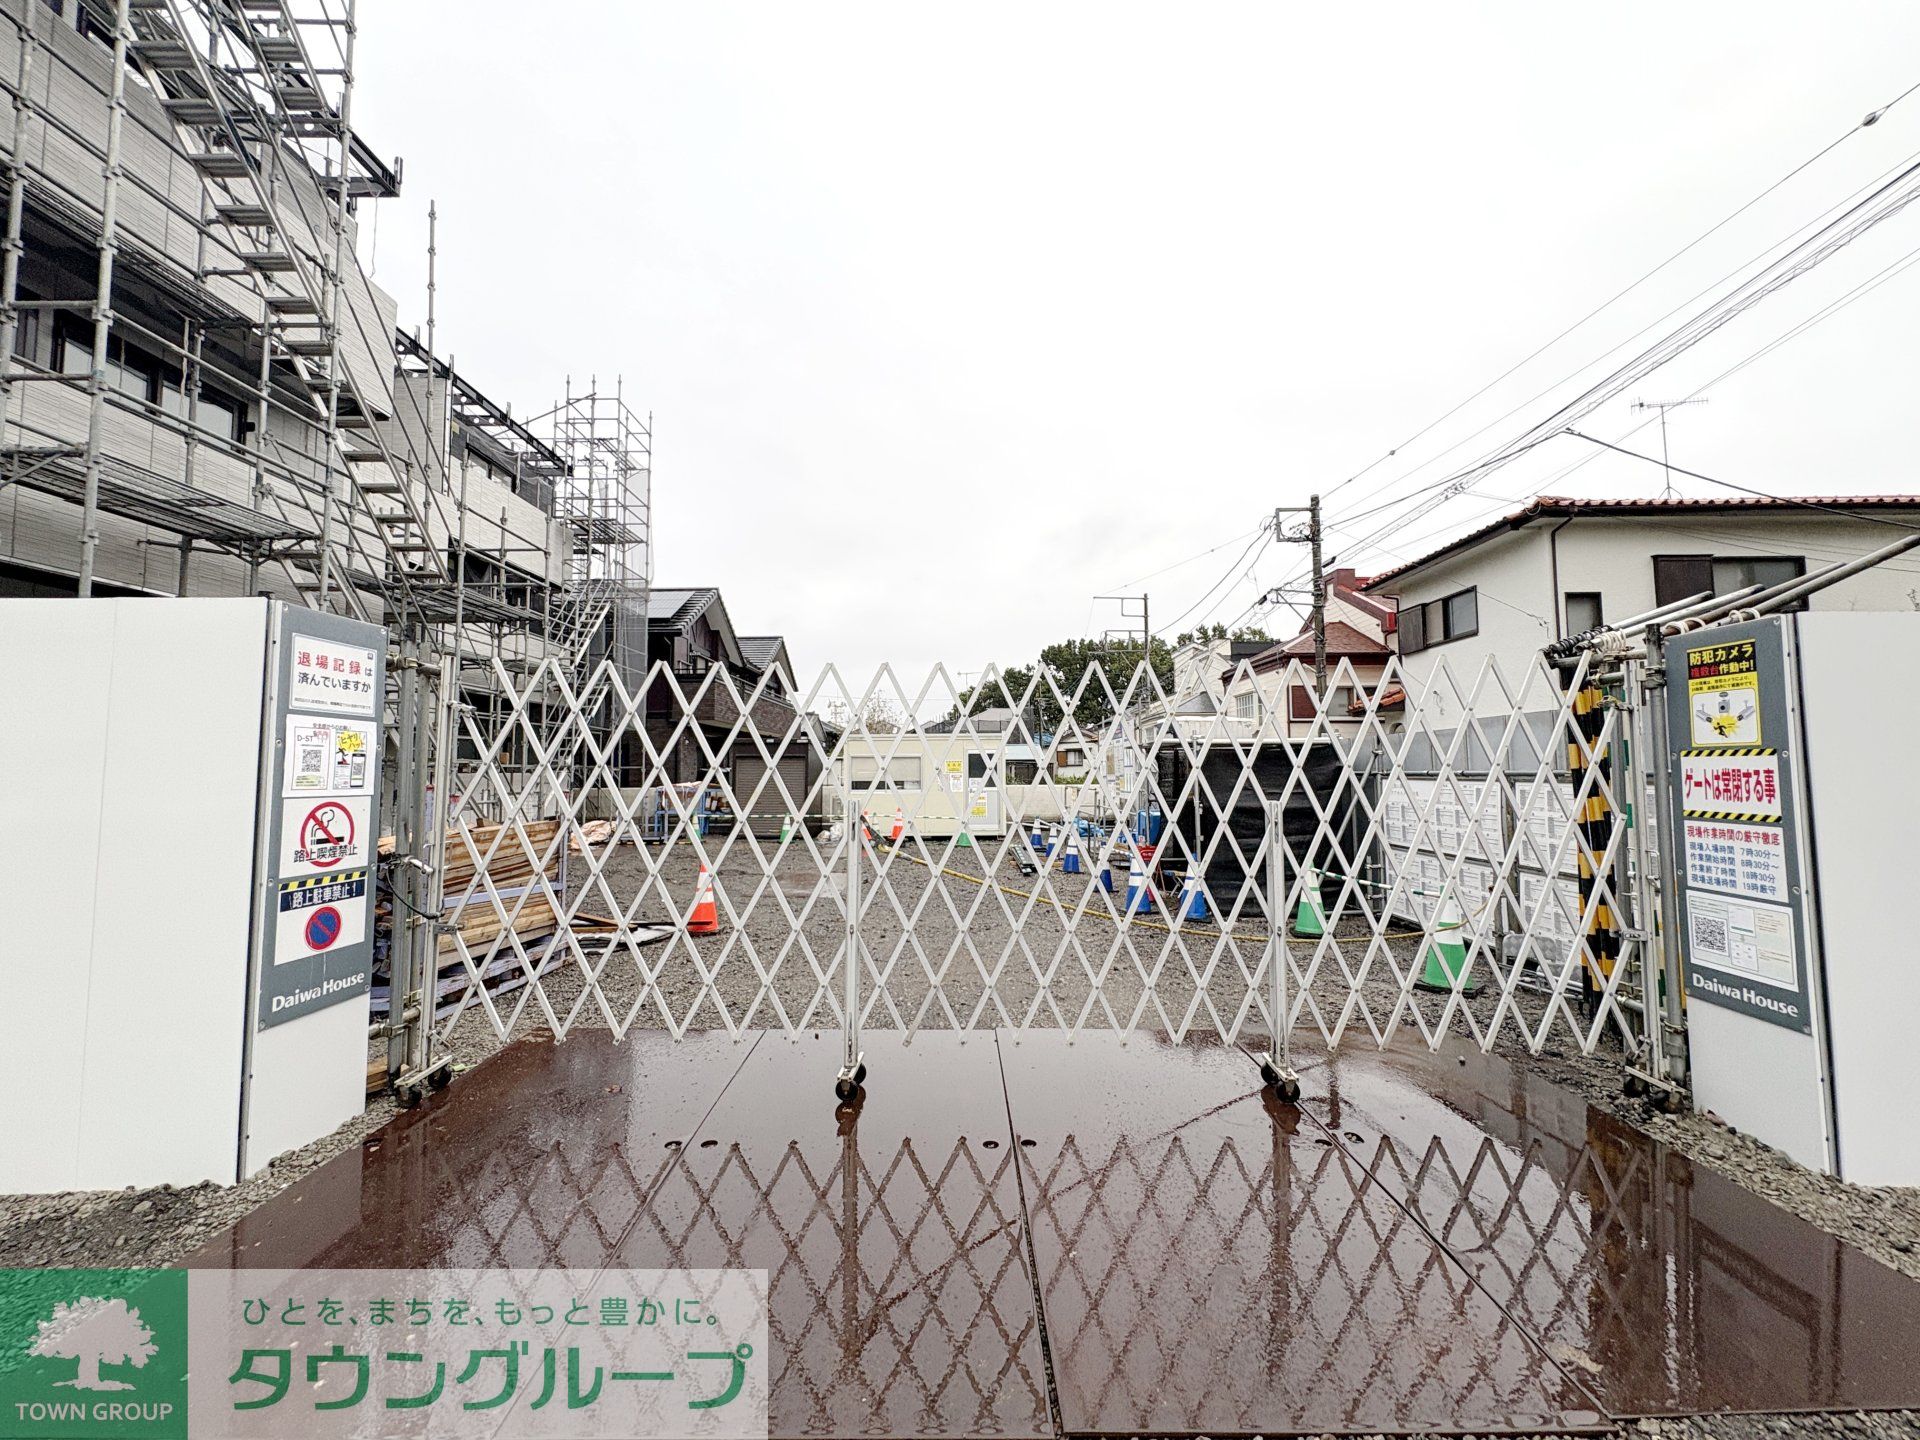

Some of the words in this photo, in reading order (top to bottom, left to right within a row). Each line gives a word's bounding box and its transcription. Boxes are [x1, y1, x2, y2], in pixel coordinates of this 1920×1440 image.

[297, 651, 373, 677] 退場記録は
[1689, 644, 1754, 666] 防犯カメラ
[298, 671, 371, 693] 済んでいますか
[1685, 768, 1777, 804] ゲートは常閉する事
[1687, 825, 1780, 846] 現場作業時間の厳守徹底
[293, 844, 358, 863] 路上喫煙禁止
